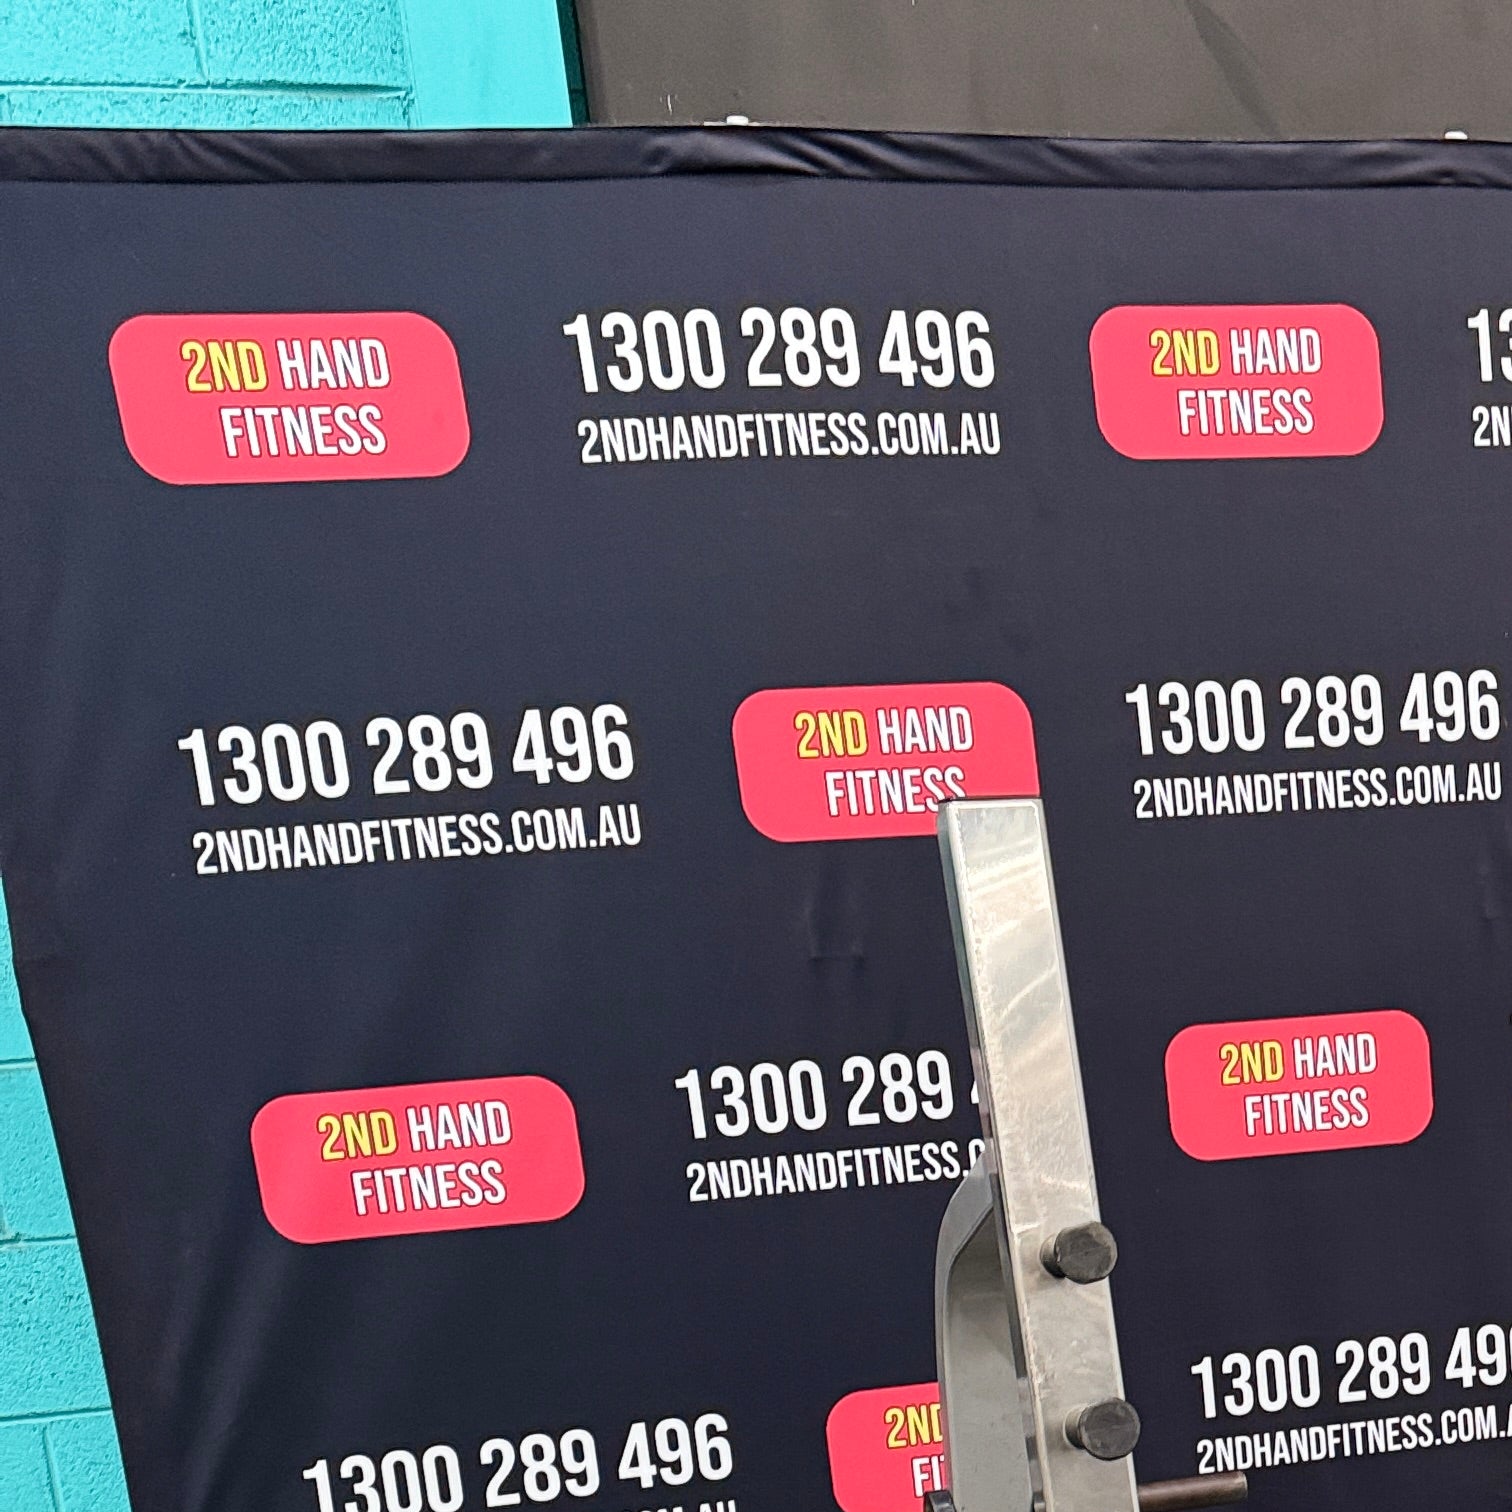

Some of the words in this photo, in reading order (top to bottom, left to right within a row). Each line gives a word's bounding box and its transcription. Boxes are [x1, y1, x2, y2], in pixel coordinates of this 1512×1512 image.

[182, 342, 266, 391] 2ND
[277, 339, 389, 389] HAND
[563, 309, 725, 392] 1300
[741, 307, 860, 387] 289
[879, 310, 994, 388] 496
[1151, 330, 1219, 374] 2ND
[1231, 328, 1321, 373] HAND
[221, 405, 385, 456] FITNESS
[578, 412, 1000, 463] 2NDHANDFITNESS.COM.AU
[1179, 389, 1313, 434] FITNESS
[795, 711, 867, 757] 2ND
[878, 707, 972, 753] HAND
[1126, 679, 1265, 755] 1300
[1281, 674, 1383, 748] 289
[1400, 670, 1499, 742] 496
[178, 721, 349, 805] 1300
[366, 712, 493, 794] 289
[513, 704, 633, 784] 496
[826, 767, 965, 815] FITNESS
[1134, 762, 1501, 818] 2NDHANDFITNESS.COM.AU
[193, 804, 641, 874] 2NDHANDFITNESS.COM.AU
[1221, 1042, 1283, 1084] 2ND
[1294, 1034, 1376, 1078] HAND
[675, 1060, 826, 1138] 1300
[842, 1051, 953, 1126] 289
[1246, 1087, 1368, 1135] FITNESS
[319, 1112, 396, 1159] 2ND
[407, 1102, 510, 1151] HAND
[353, 1160, 505, 1215] FITNESS
[1191, 1345, 1320, 1418] 1300
[1336, 1333, 1430, 1403] 289
[480, 1429, 599, 1507] 289
[619, 1414, 732, 1488] 496
